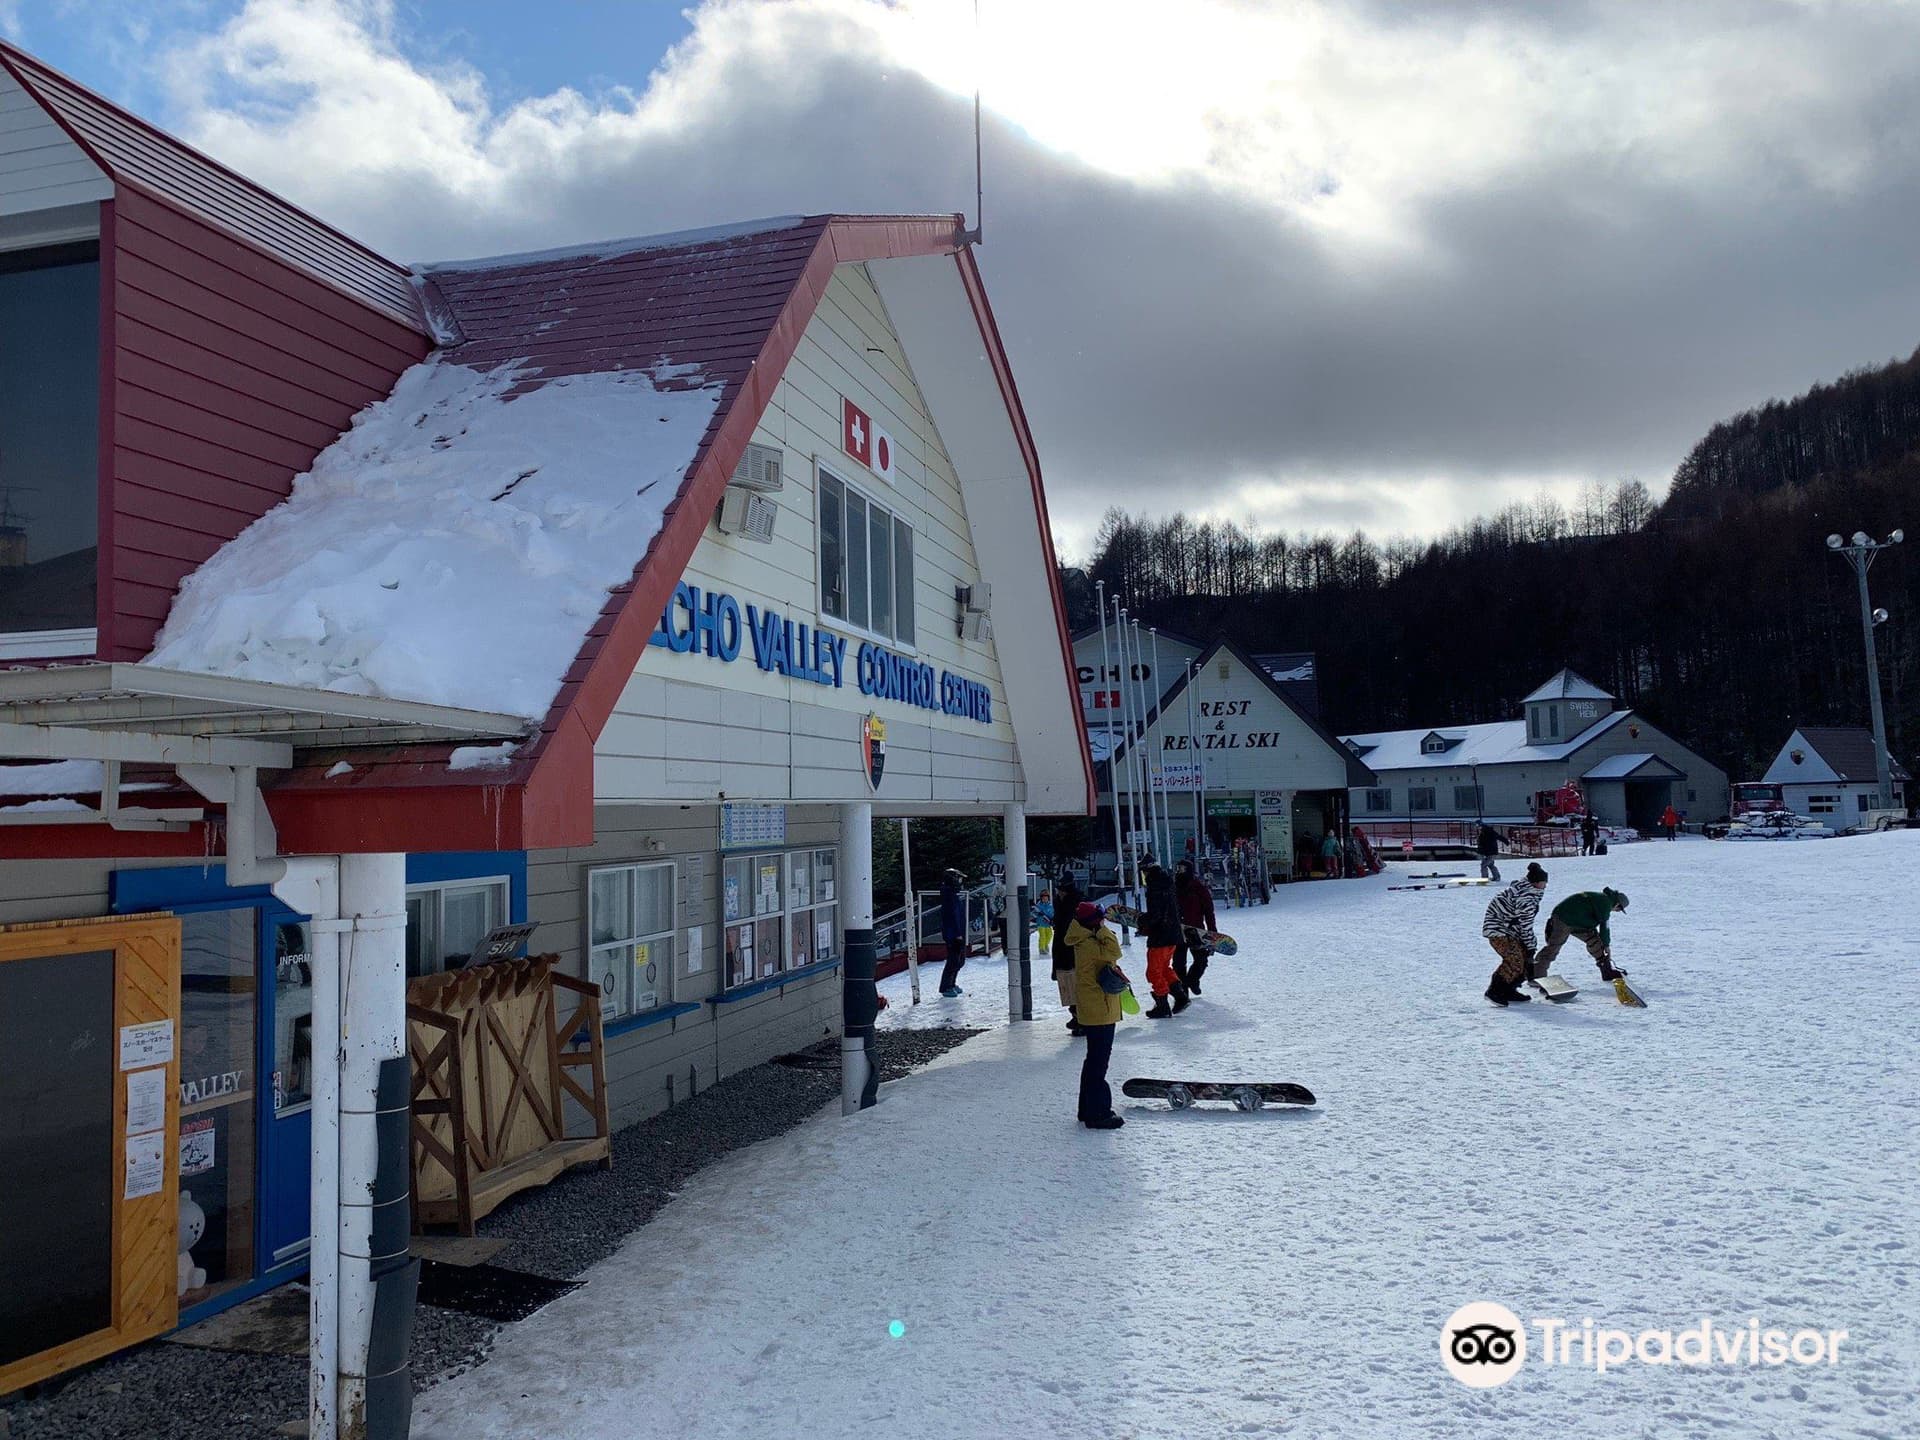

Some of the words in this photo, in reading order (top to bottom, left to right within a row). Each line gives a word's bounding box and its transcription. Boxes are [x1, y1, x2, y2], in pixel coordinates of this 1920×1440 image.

[746, 604, 848, 688] VALLEY
[858, 642, 940, 711] CONTROL
[941, 670, 993, 724] CENTER
[1197, 700, 1252, 717] REST
[1215, 719, 1225, 731] &
[1245, 732, 1281, 748] SKI
